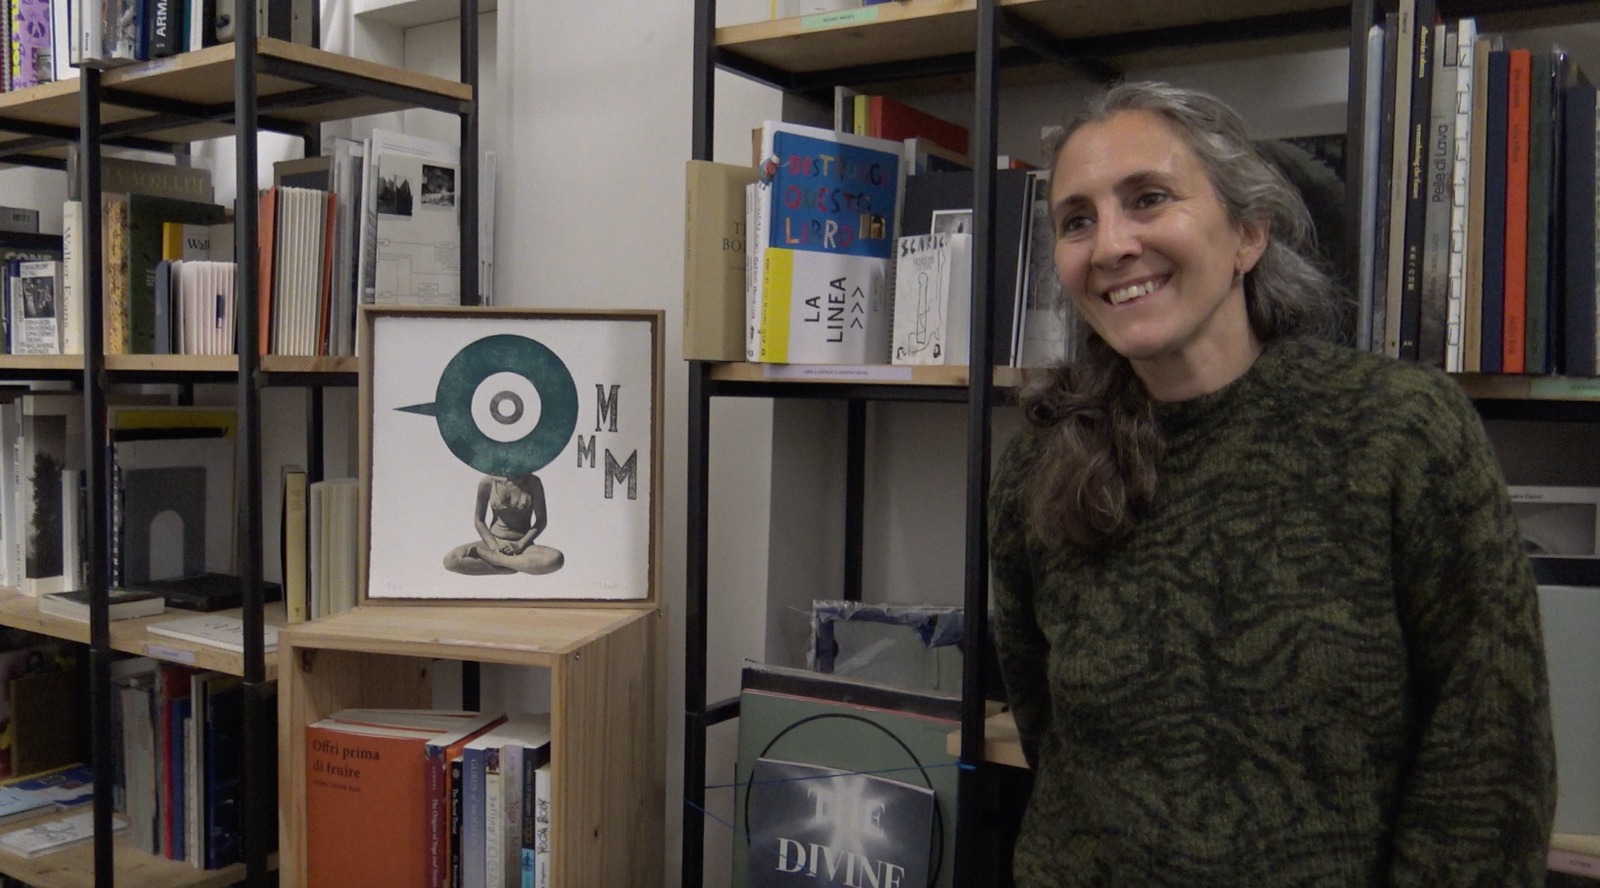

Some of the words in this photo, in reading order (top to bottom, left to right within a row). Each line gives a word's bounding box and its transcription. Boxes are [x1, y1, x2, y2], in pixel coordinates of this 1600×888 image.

[156, 0, 168, 37] ARM
[1436, 124, 1448, 156] Lava
[1434, 158, 1446, 171] di
[785, 184, 872, 214] QUESTO
[1432, 173, 1445, 203] Pelle
[187, 238, 210, 250] Wall
[784, 216, 854, 249] LIBRO
[804, 296, 821, 322] LA
[826, 276, 847, 342] LINEA
[595, 384, 621, 433] M
[577, 434, 596, 468] M
[604, 448, 638, 500] M
[313, 738, 339, 755] Offri
[342, 746, 380, 760] prima
[313, 760, 324, 772] di
[327, 762, 361, 779] fruire
[489, 796, 497, 833] Selling
[537, 798, 550, 824] BODY
[537, 828, 550, 855] YOGA
[488, 835, 497, 884] YOGA
[775, 837, 904, 888] DIVINE
